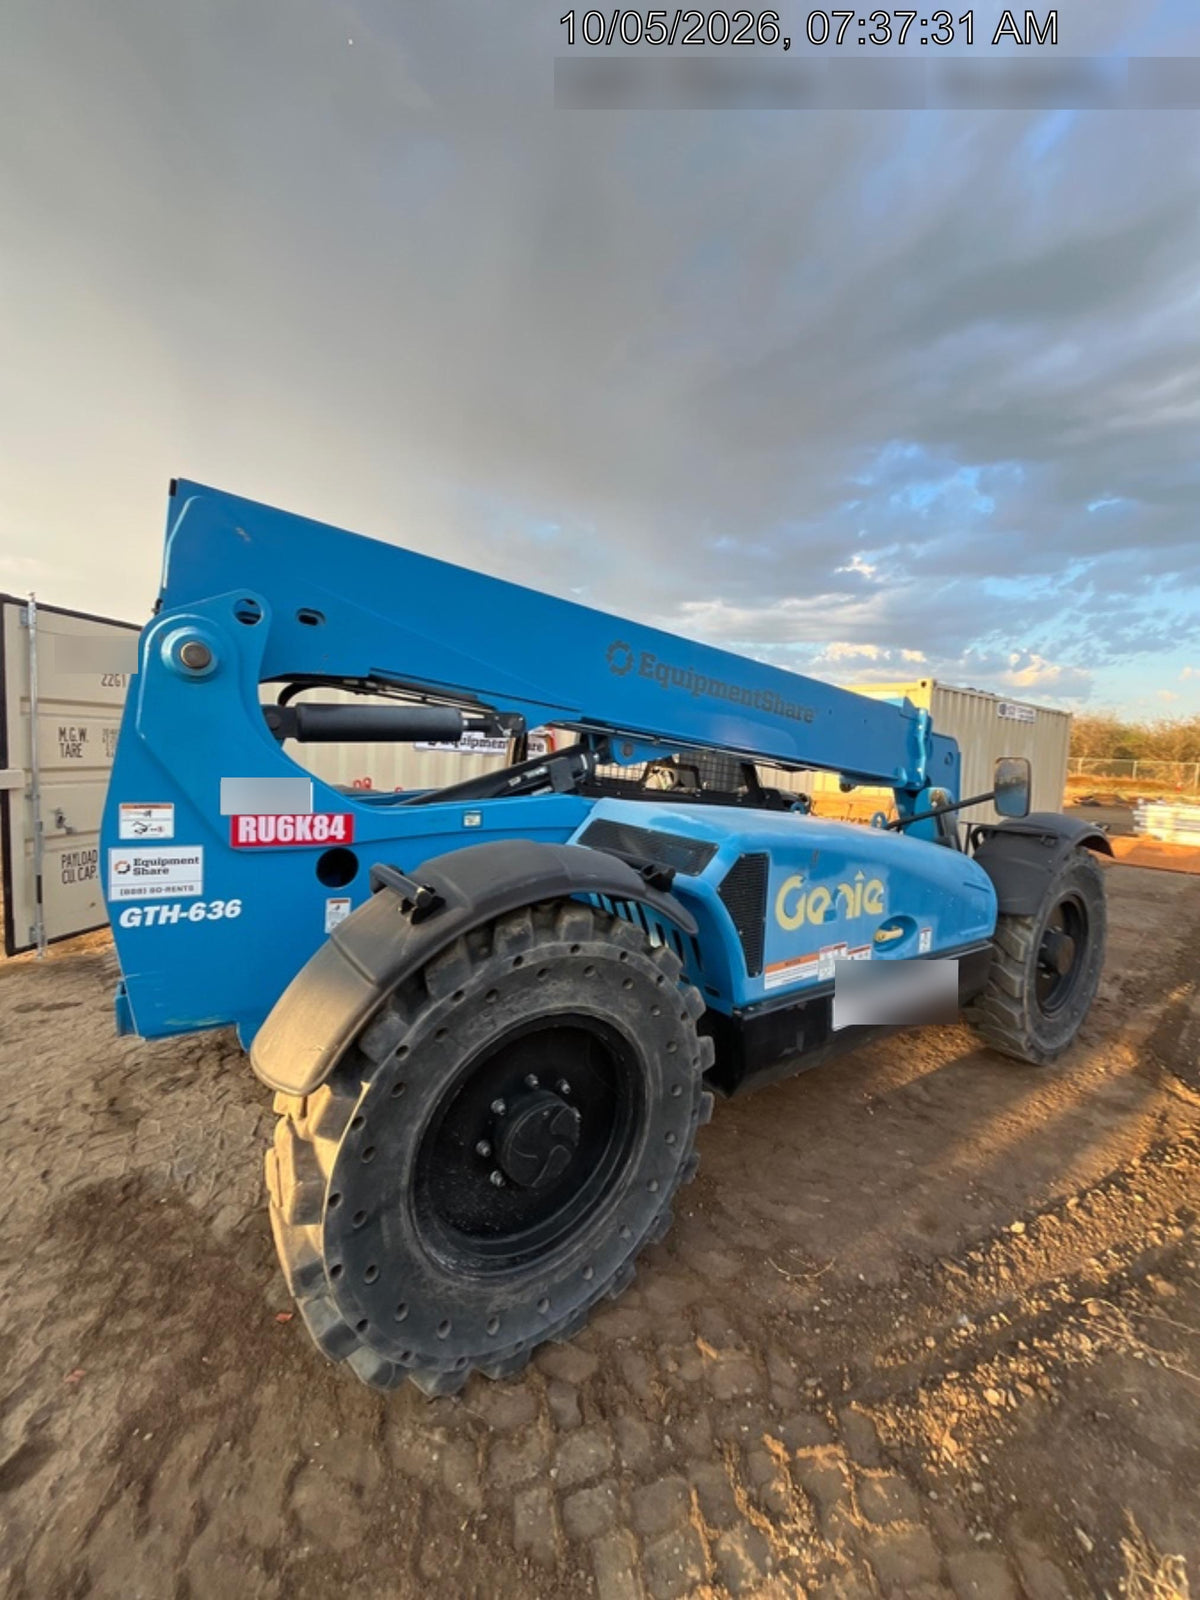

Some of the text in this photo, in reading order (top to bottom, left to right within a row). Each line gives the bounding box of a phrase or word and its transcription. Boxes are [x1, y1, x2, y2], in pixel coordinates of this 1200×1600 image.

[638, 651, 817, 724] EquipmentShare
[60, 742, 83, 758] TARE
[237, 815, 346, 844] RU6K84
[61, 850, 98, 869] PAYLOAD
[133, 857, 200, 867] Equipment
[133, 867, 169, 876] Share
[775, 870, 884, 931] Genie
[119, 899, 242, 928] GTH-636
